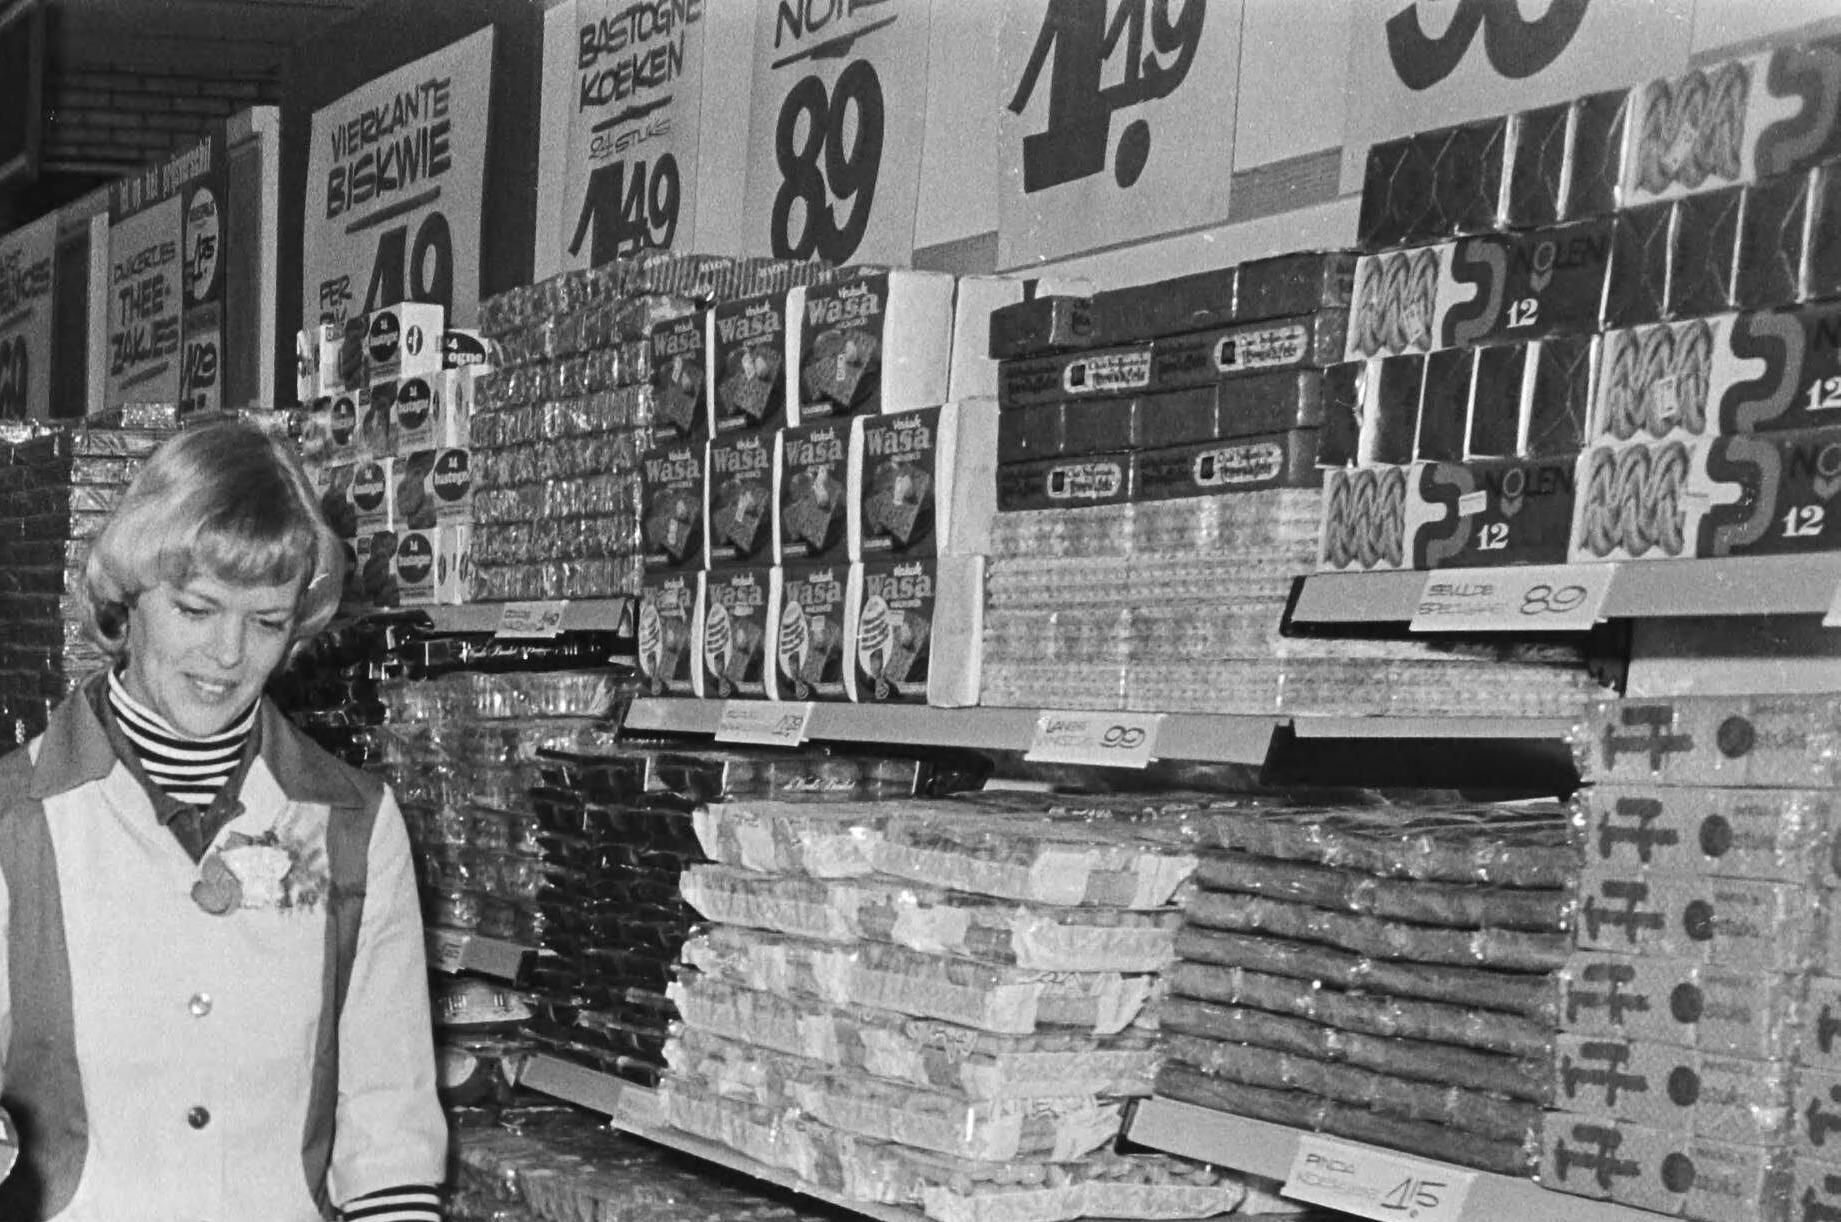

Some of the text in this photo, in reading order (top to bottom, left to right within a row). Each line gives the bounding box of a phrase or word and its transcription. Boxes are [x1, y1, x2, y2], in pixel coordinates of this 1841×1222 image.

[578, 0, 703, 70] BASTOGNE
[580, 31, 685, 113] KOEKEN
[329, 77, 452, 163] VIERKANTE
[326, 119, 452, 220] BISKWIE
[770, 59, 886, 267] 89
[809, 291, 880, 327] Wasa
[1506, 297, 1539, 329] 12
[653, 328, 701, 357] Wasa
[717, 309, 781, 345] Wasa
[786, 436, 843, 466] Wasa
[866, 426, 931, 457] Wasa
[645, 457, 700, 484] Wasa
[713, 446, 770, 475] Wasa
[1477, 521, 1510, 551] 12
[1782, 504, 1825, 537] 12
[709, 581, 763, 608] Wasa
[786, 578, 843, 607] Wasa
[865, 573, 936, 601] Wasa
[1520, 585, 1588, 616] 89
